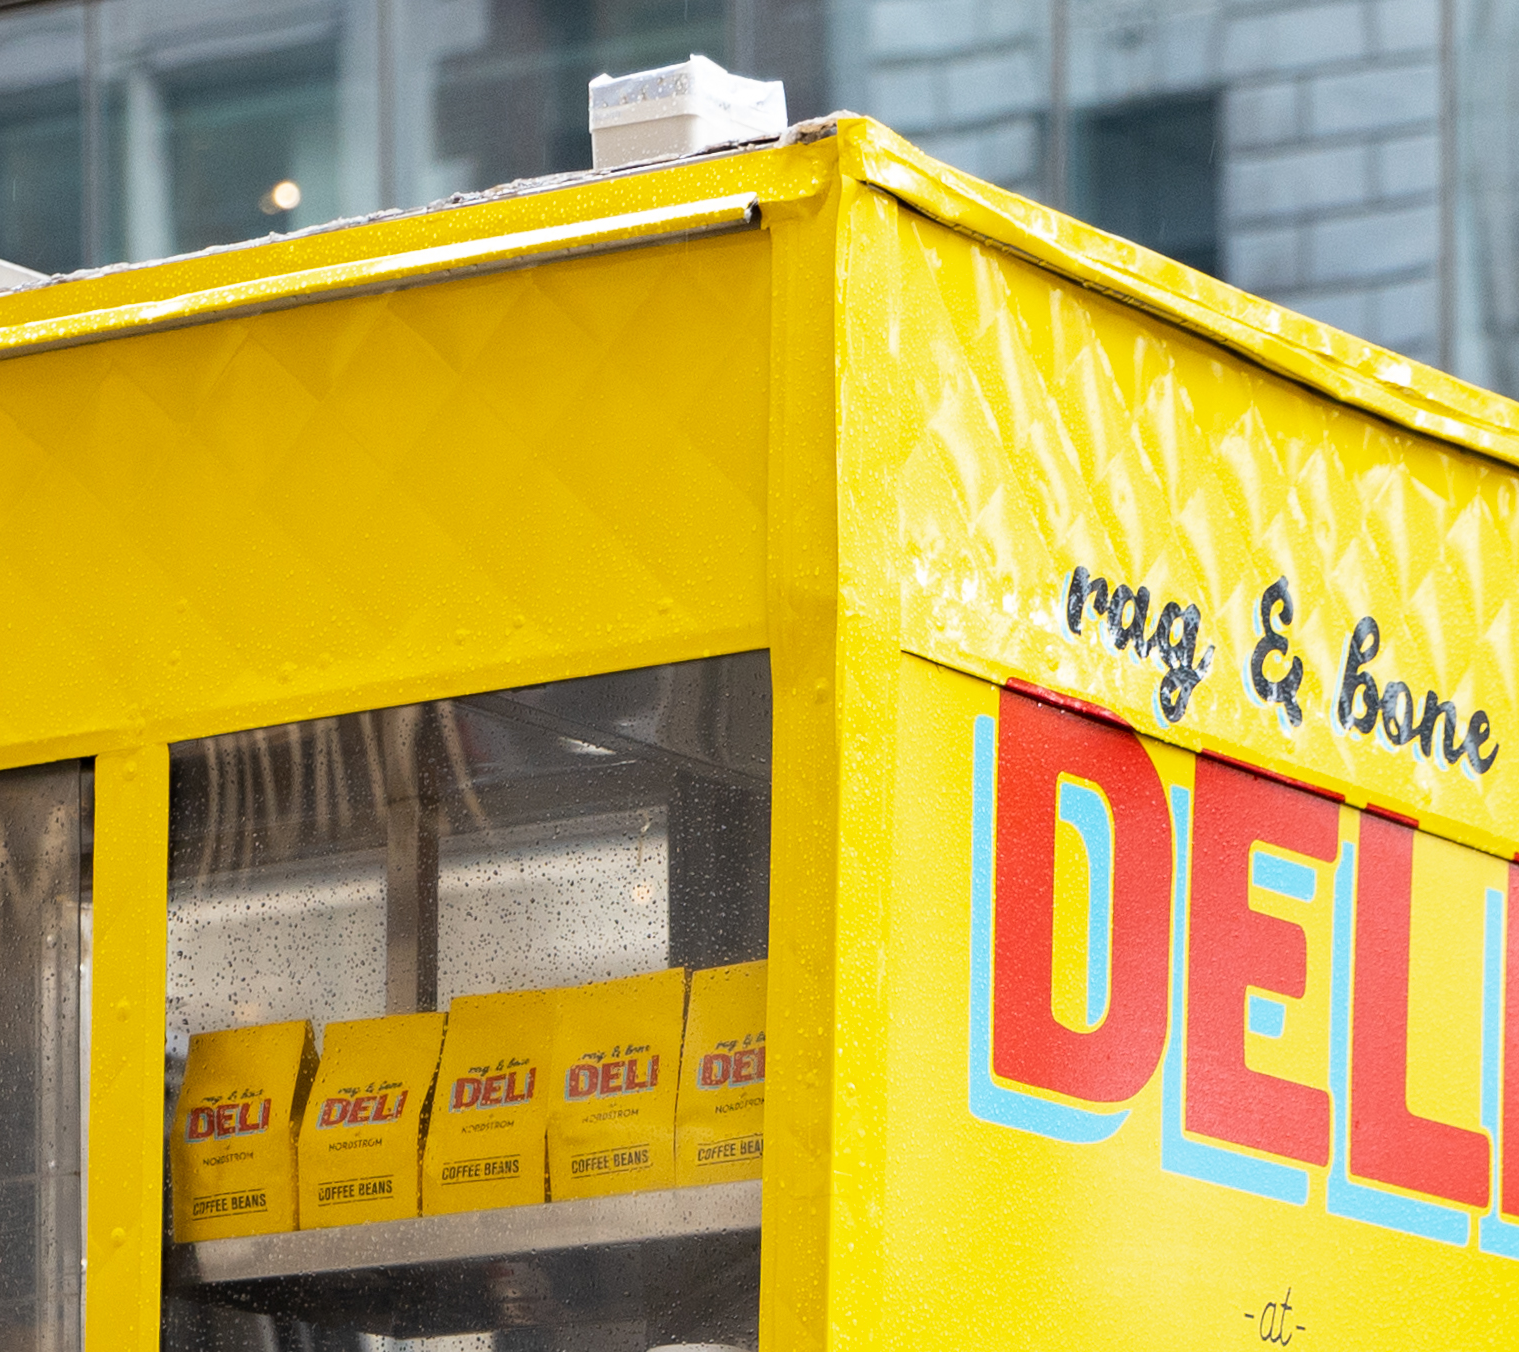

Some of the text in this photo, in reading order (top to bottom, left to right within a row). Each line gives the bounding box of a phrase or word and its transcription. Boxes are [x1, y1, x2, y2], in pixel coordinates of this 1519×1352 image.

[1061, 566, 1499, 779] rag & bone
[448, 1067, 537, 1113] DELI
[565, 1055, 660, 1102] DELI
[184, 1098, 272, 1144] DELI
[316, 1090, 408, 1130] DELI
[571, 1149, 649, 1174] COFFEE BEANS
[698, 1144, 735, 1161] COFFEE
[442, 1160, 519, 1181] COFFEE BEANS
[193, 1194, 266, 1216] COFFEE BEANS
[318, 1180, 392, 1202] COFFEE BEANS
